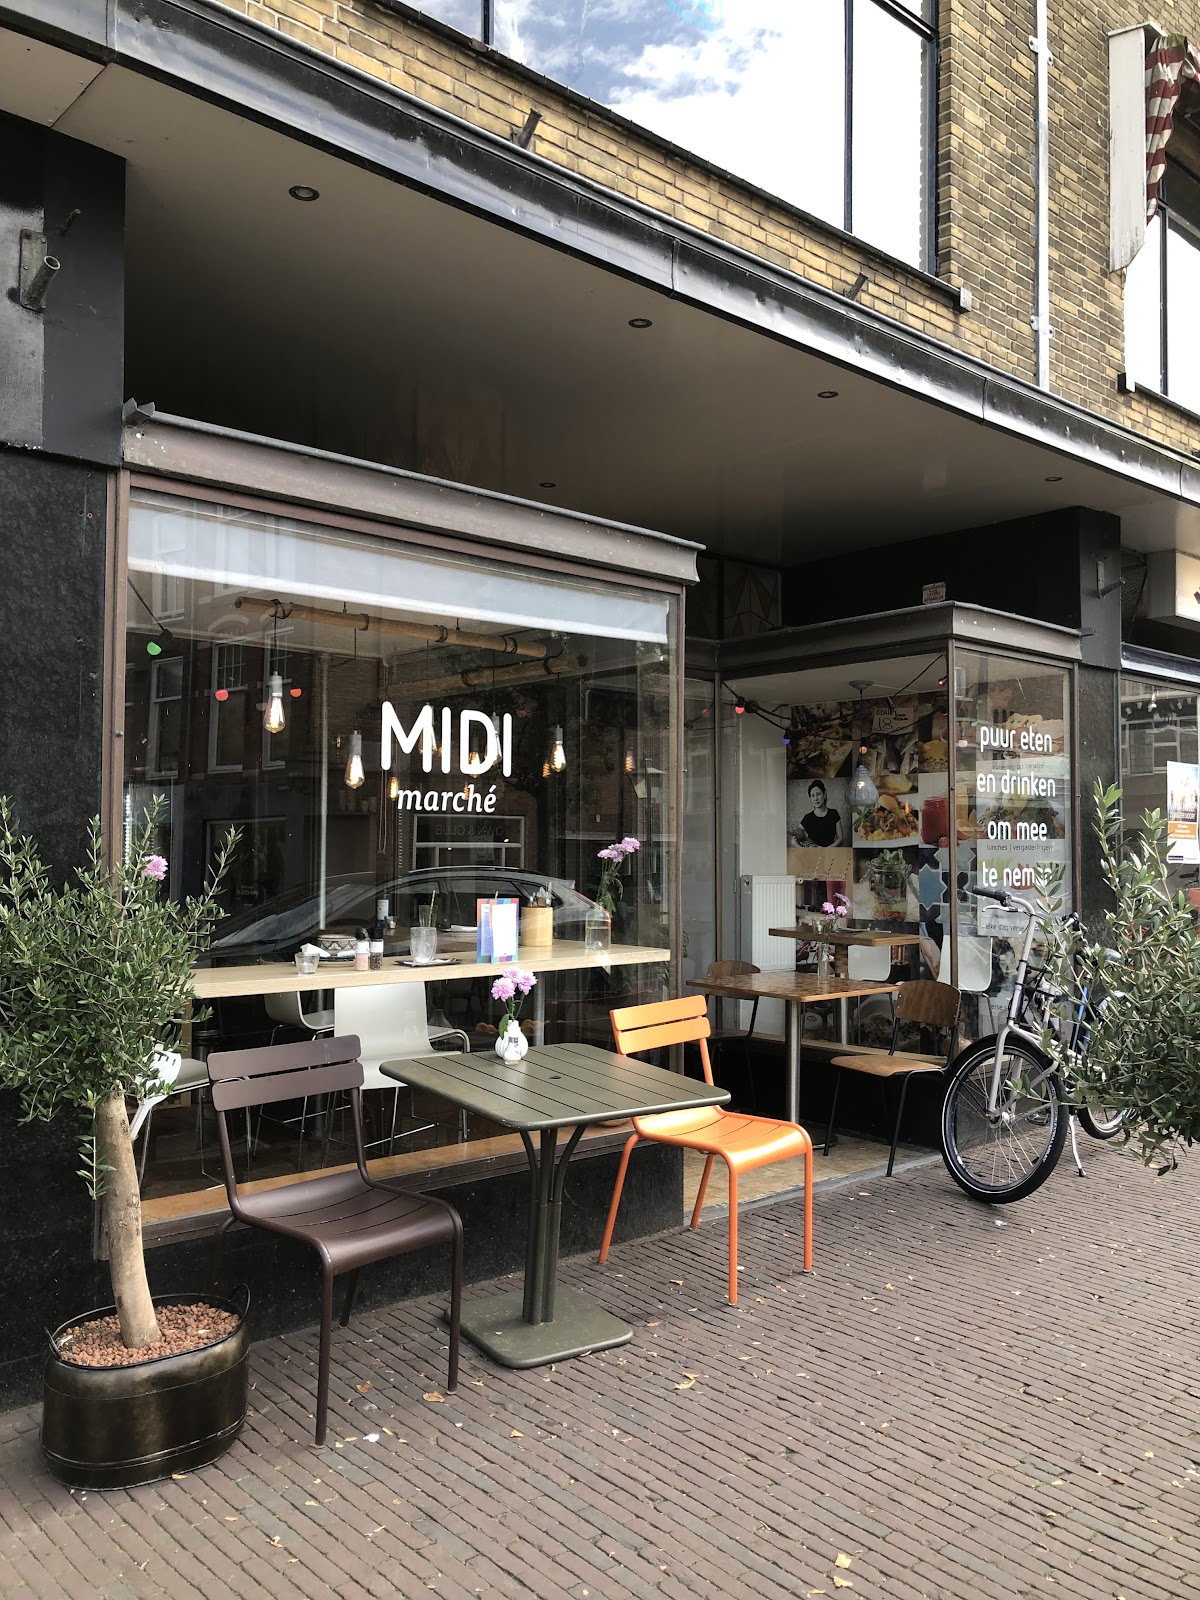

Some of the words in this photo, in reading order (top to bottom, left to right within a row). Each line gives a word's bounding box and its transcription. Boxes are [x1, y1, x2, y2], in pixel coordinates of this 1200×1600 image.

[380, 700, 513, 778] MIDI
[980, 726, 1016, 753] puur
[1020, 727, 1053, 753] eten
[976, 772, 996, 793] en
[1001, 769, 1056, 798] drinken
[397, 784, 497, 813] marché
[987, 820, 1012, 841] om
[1016, 821, 1048, 842] mee
[982, 861, 998, 887] te
